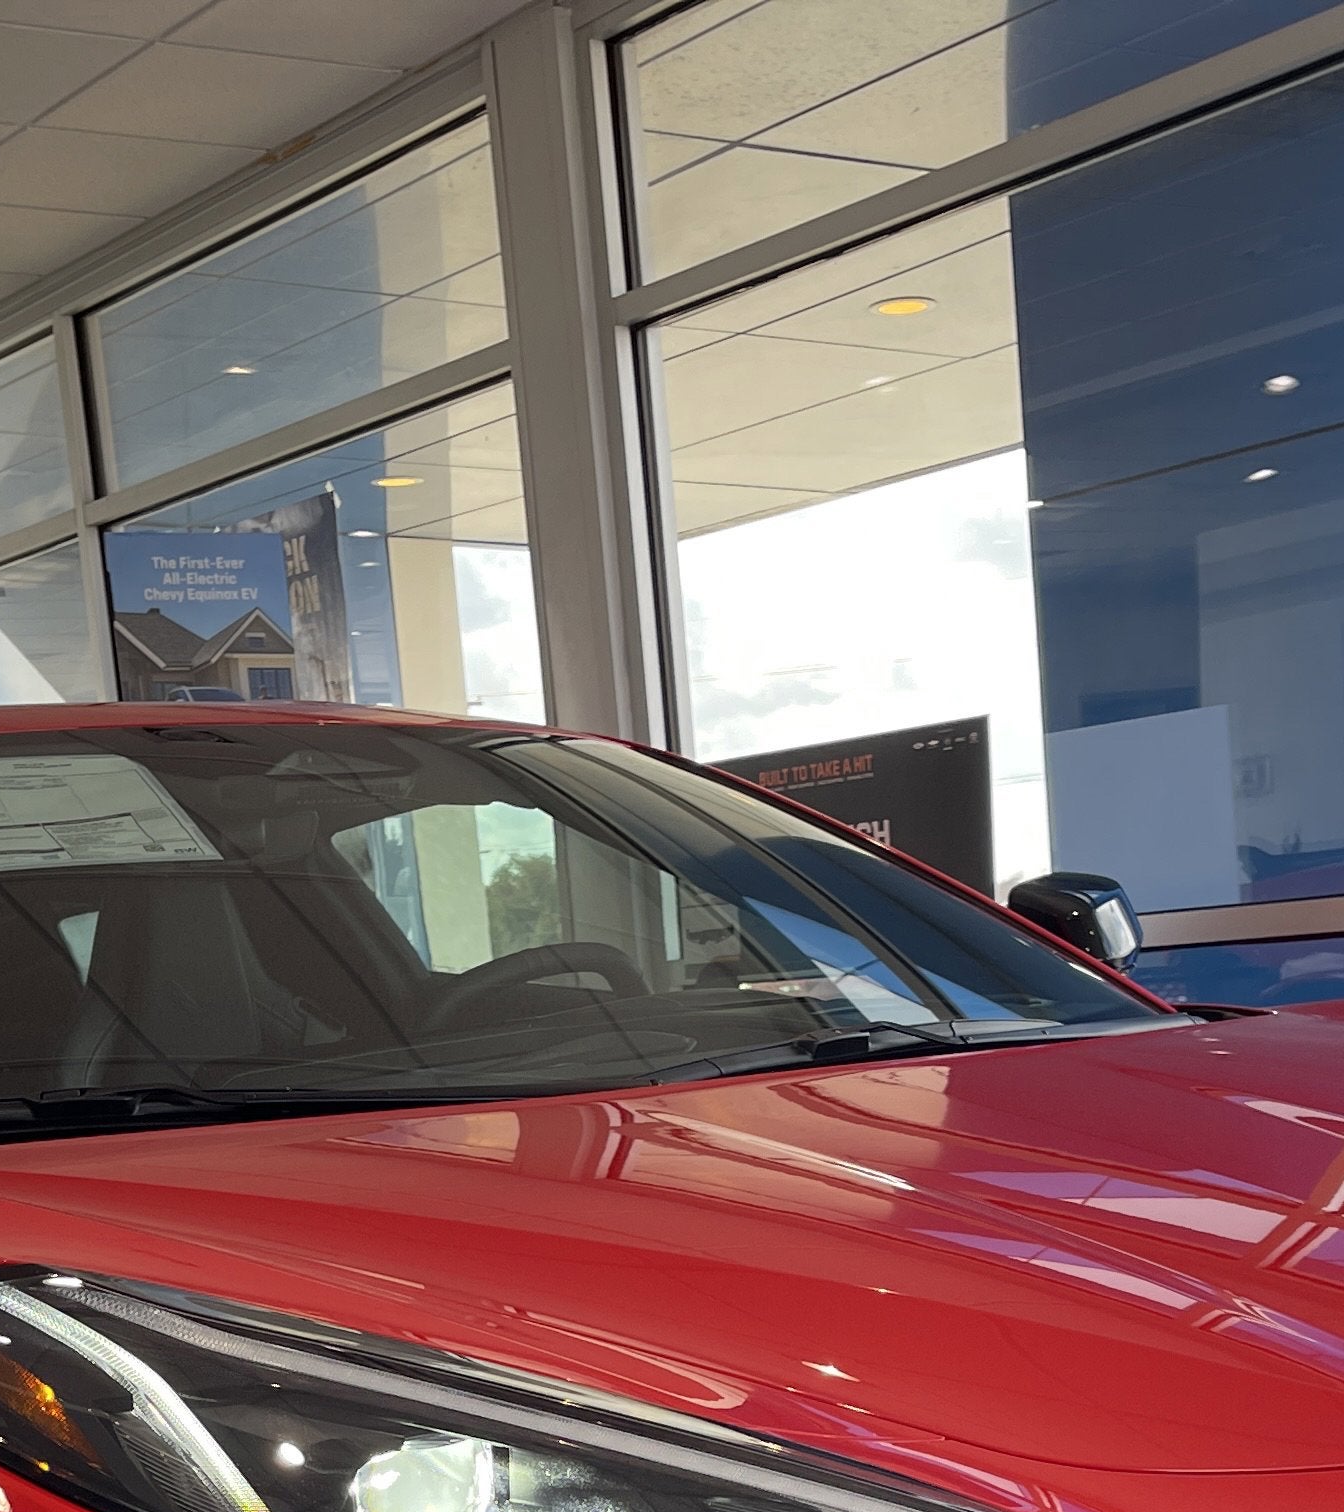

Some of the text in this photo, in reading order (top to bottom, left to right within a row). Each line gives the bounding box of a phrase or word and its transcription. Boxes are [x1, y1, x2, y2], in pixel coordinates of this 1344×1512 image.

[151, 556, 246, 569] The First-Ever
[162, 571, 238, 585] All-Electric
[143, 587, 258, 603] Chevy Equinox EV
[758, 754, 873, 786] BUILT TO TAKE A HIT
